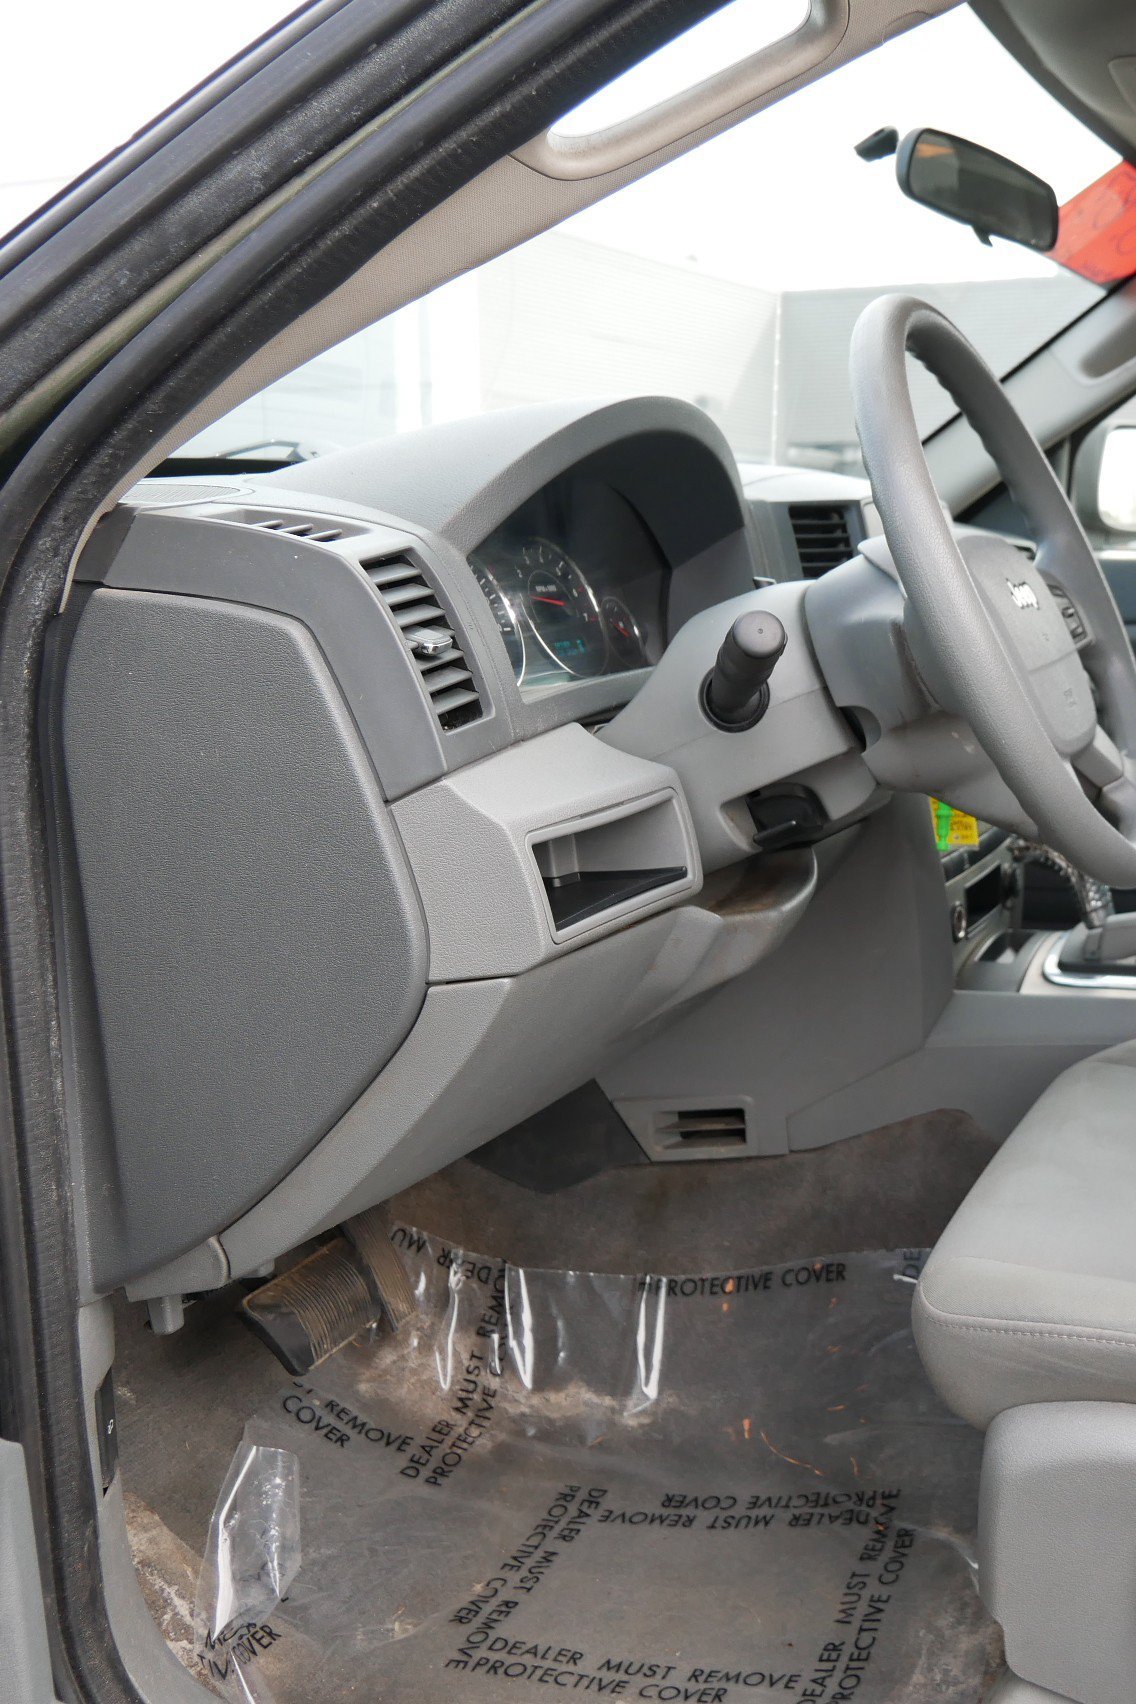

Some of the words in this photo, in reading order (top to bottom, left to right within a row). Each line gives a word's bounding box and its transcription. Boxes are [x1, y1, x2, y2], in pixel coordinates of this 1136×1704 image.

[781, 1262, 847, 1288] COVER
[283, 1395, 351, 1448] COVER
[324, 1400, 415, 1453] REMOVE
[400, 1418, 453, 1478] DEALER
[453, 1350, 484, 1415] MUST
[425, 1387, 498, 1487] PROTECTIVE
[553, 1487, 608, 1543] DEALER
[598, 1508, 698, 1528] REMOVE
[660, 1492, 737, 1511] COVER
[705, 1513, 775, 1530] MUST
[788, 1508, 870, 1527] DEALER
[500, 1484, 581, 1573] PROTECTIVE
[513, 1550, 560, 1594] MUST
[878, 1528, 917, 1585] COVER
[448, 1577, 507, 1625] COVER
[833, 1571, 871, 1625] MUST
[444, 1600, 519, 1670] REMOVE
[471, 1656, 630, 1694] PROTECTIVE
[638, 1684, 728, 1703] COVER
[487, 1637, 584, 1667] DEALER
[597, 1658, 677, 1680] MUST
[687, 1668, 801, 1690] REMOVE
